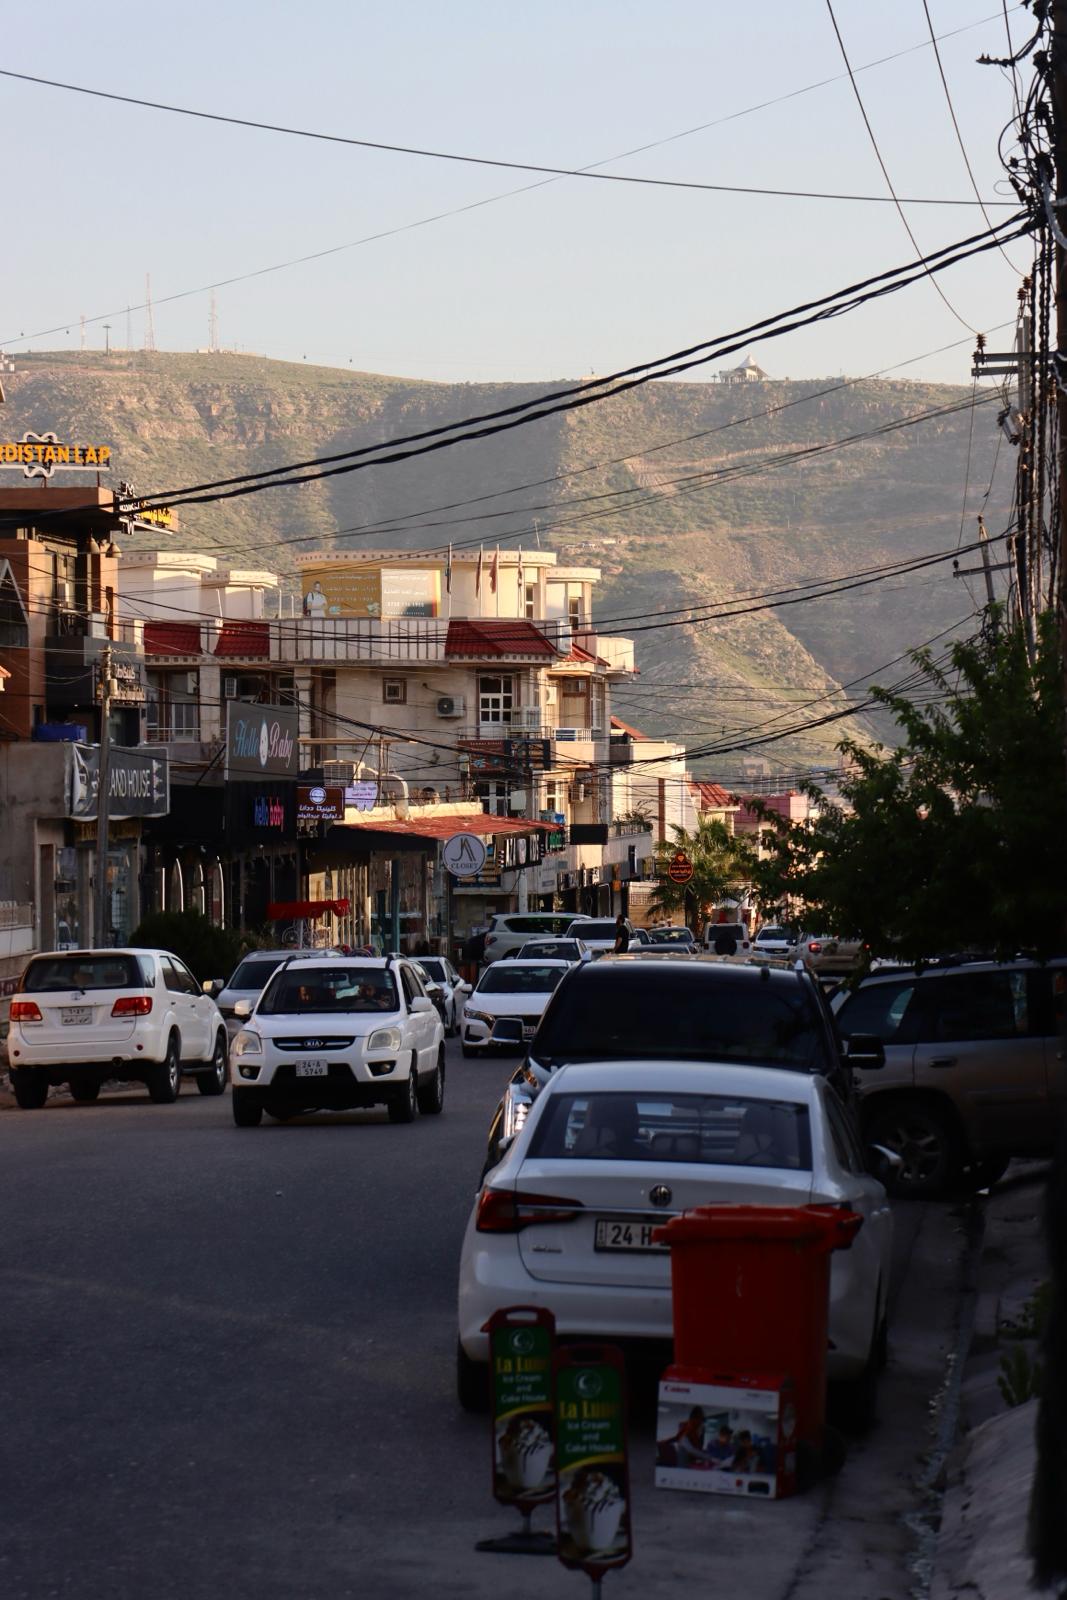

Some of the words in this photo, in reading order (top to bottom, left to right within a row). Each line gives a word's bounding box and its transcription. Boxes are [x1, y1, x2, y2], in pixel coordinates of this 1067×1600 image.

[75, 446, 111, 464] LAP
[234, 719, 259, 758] Hello
[268, 721, 294, 768] Baby
[128, 769, 151, 799] HOUSE
[451, 862, 479, 870] CLOSET
[306, 1040, 322, 1048] KIA
[611, 1225, 633, 1246] 24
[496, 1356, 512, 1374] La
[516, 1373, 543, 1384] Cream
[516, 1384, 532, 1393] and
[521, 1392, 547, 1402] House
[559, 1399, 577, 1420] La
[581, 1420, 610, 1431] Cream
[582, 1432, 601, 1442] and
[588, 1443, 617, 1453] House
